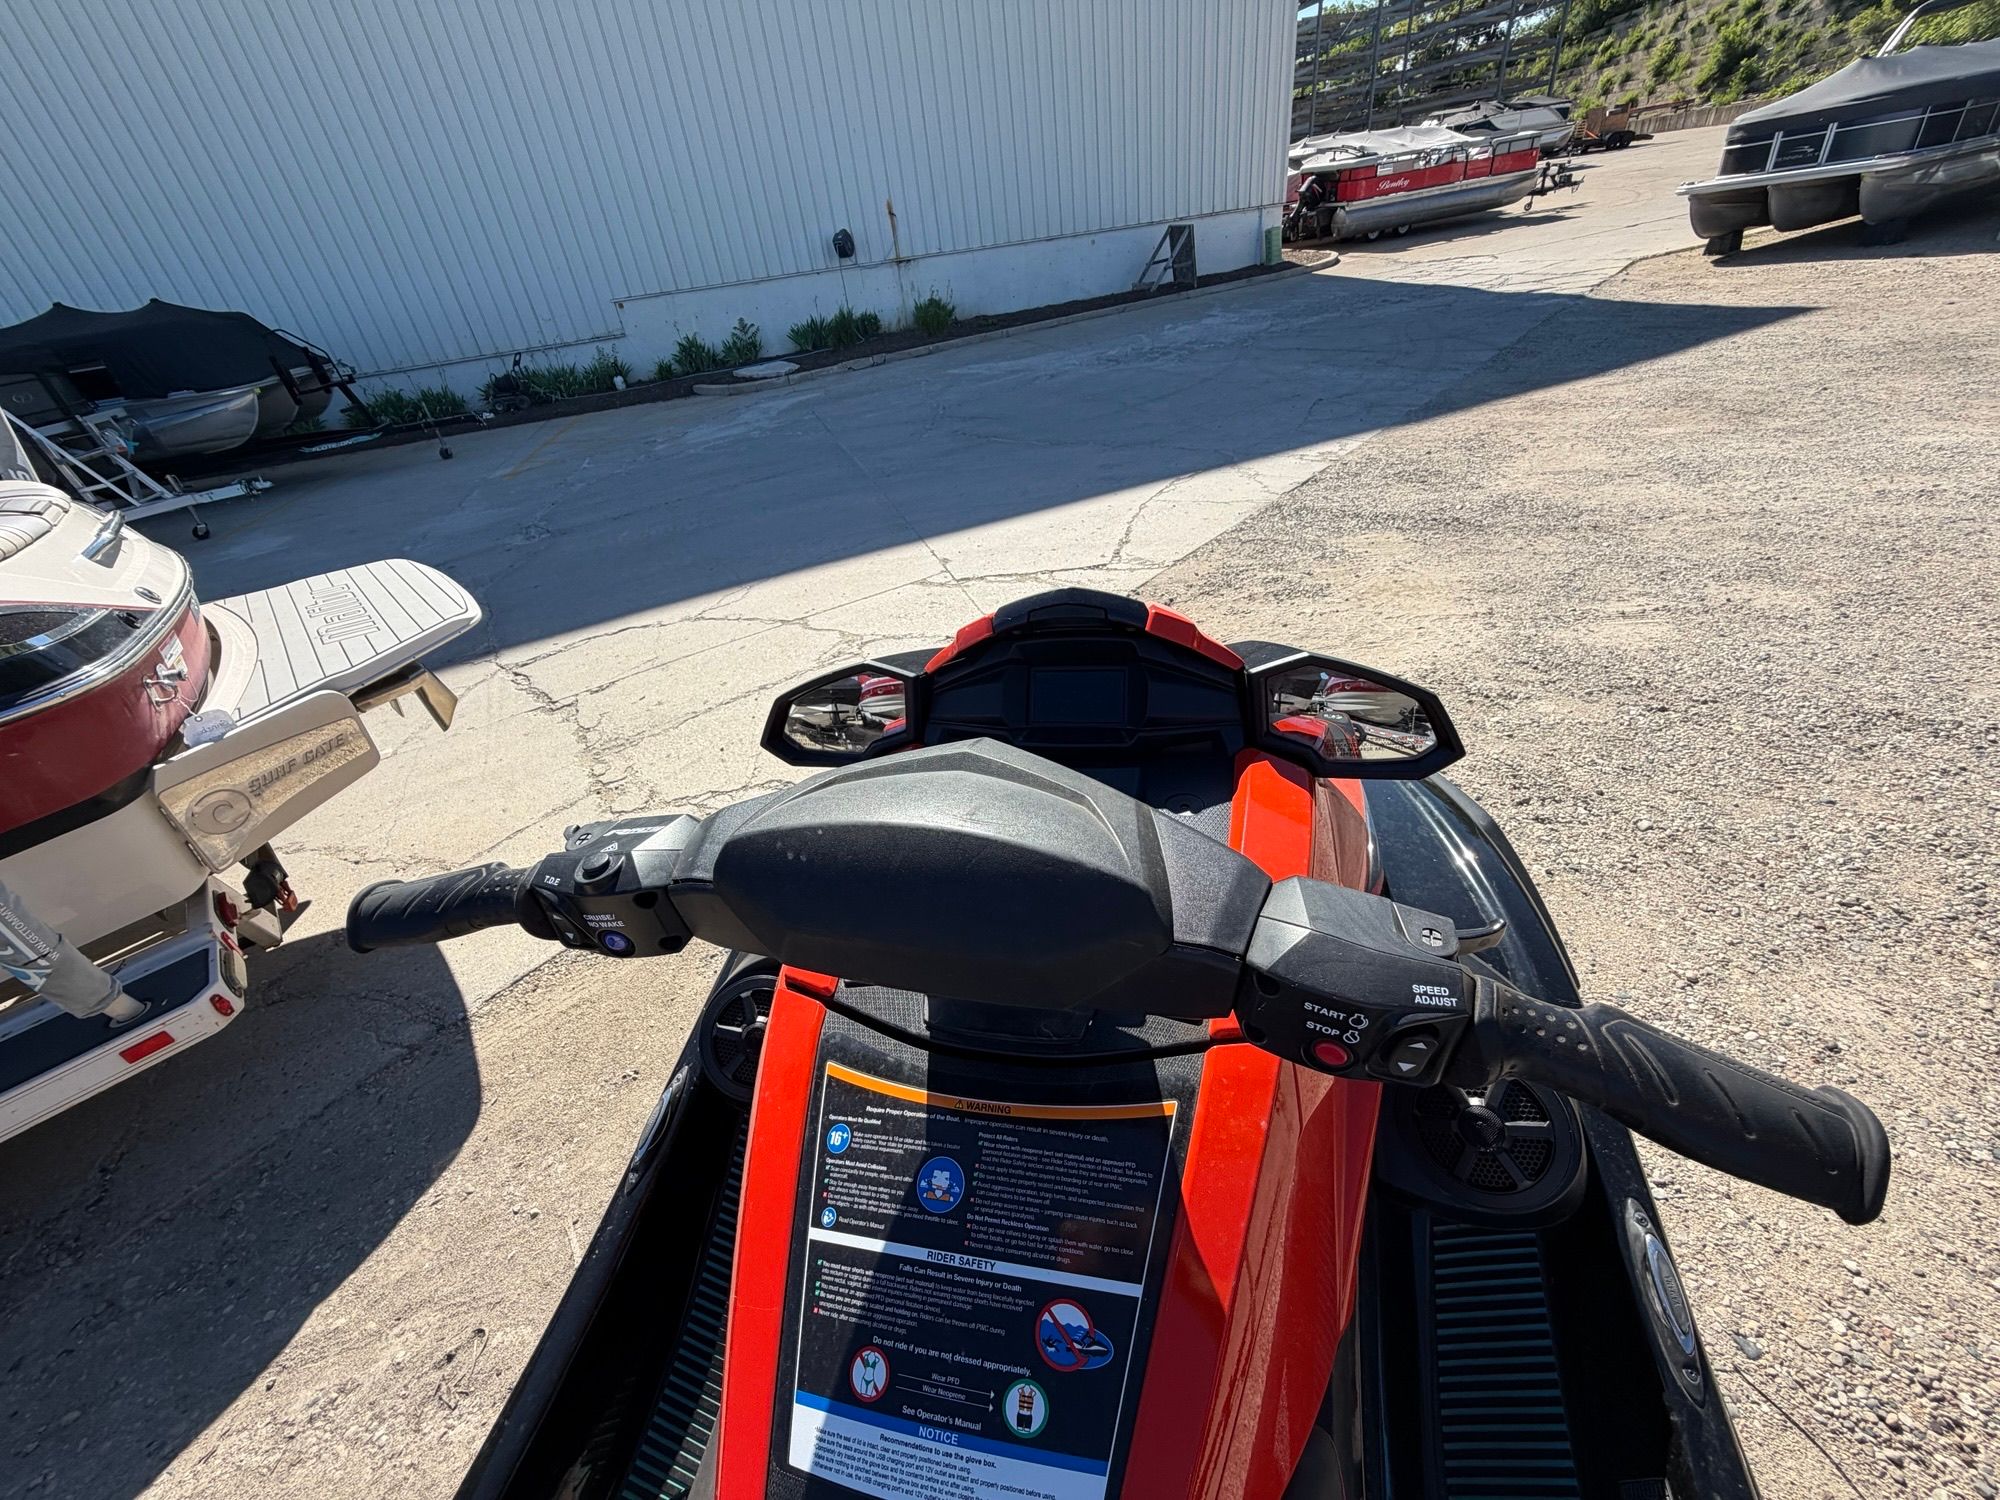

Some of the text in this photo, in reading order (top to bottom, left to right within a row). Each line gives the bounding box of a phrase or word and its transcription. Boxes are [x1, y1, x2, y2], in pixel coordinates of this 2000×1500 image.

[1376, 177, 1410, 191] Bentley
[305, 583, 381, 645] Malibu
[248, 733, 345, 795] SURF GATE
[543, 875, 561, 886] T.D.E
[583, 913, 616, 922] CRUISE/
[587, 920, 625, 929] NO WAKE
[0, 903, 60, 962] WWW.GETTOMMY
[1412, 984, 1449, 996] SPEED
[1414, 995, 1458, 1007] ADJUST
[1303, 1002, 1347, 1021] START
[1306, 1021, 1340, 1036] STOP
[966, 1102, 1012, 1114] WARNING
[829, 1114, 848, 1122] Operators
[866, 1106, 885, 1114] Require
[903, 1111, 929, 1119] Operation
[964, 1118, 988, 1126] Improper
[989, 1121, 1015, 1130] operation
[1068, 1132, 1084, 1140] injury
[826, 1158, 845, 1166] Operators
[849, 1219, 869, 1228] Operator's
[1001, 1220, 1024, 1228] Reckless
[1024, 1223, 1050, 1233] Operation
[927, 1251, 996, 1271] RIDER SAFETY
[1005, 1248, 1032, 1258] consuming
[899, 1264, 913, 1272] Falls
[927, 1269, 946, 1278] Result
[954, 1274, 975, 1283] Severe
[975, 1278, 993, 1288] Injury
[1003, 1283, 1022, 1292] Death
[855, 1290, 875, 1300] approved
[905, 1301, 924, 1309] flotation
[849, 1316, 872, 1327] consuming
[873, 1321, 887, 1329] alcohol
[873, 1337, 882, 1345] Do
[883, 1339, 894, 1347] not
[895, 1342, 907, 1350] ride
[914, 1347, 927, 1356] you
[940, 1351, 952, 1360] not
[954, 1354, 982, 1366] dressed
[983, 1360, 1032, 1377] appropriately.
[931, 1374, 960, 1385] Wear PFD
[922, 1385, 966, 1402] Wear Neoprene
[902, 1406, 982, 1431] See Operator's Manual
[918, 1426, 959, 1445] NOTICE
[880, 1434, 933, 1453] Recommendations
[954, 1453, 964, 1461] the
[965, 1455, 982, 1466] glove
[983, 1460, 997, 1468] box.
[880, 1445, 891, 1453] clear
[900, 1451, 918, 1462] properly
[919, 1456, 942, 1468] positioned
[943, 1462, 957, 1470] before
[844, 1453, 856, 1461] inside
[869, 1461, 880, 1470] glove
[905, 1470, 925, 1480] contents
[925, 1476, 939, 1484] before
[854, 1446, 868, 1456] around
[876, 1453, 886, 1461] USB
[886, 1456, 905, 1467] charging
[905, 1461, 915, 1470] port
[916, 1463, 924, 1471] and
[934, 1468, 948, 1477] outlet
[957, 1474, 969, 1482] intact
[980, 1480, 999, 1490] properly
[1000, 1484, 1025, 1496] positioned
[1025, 1489, 1041, 1497] before
